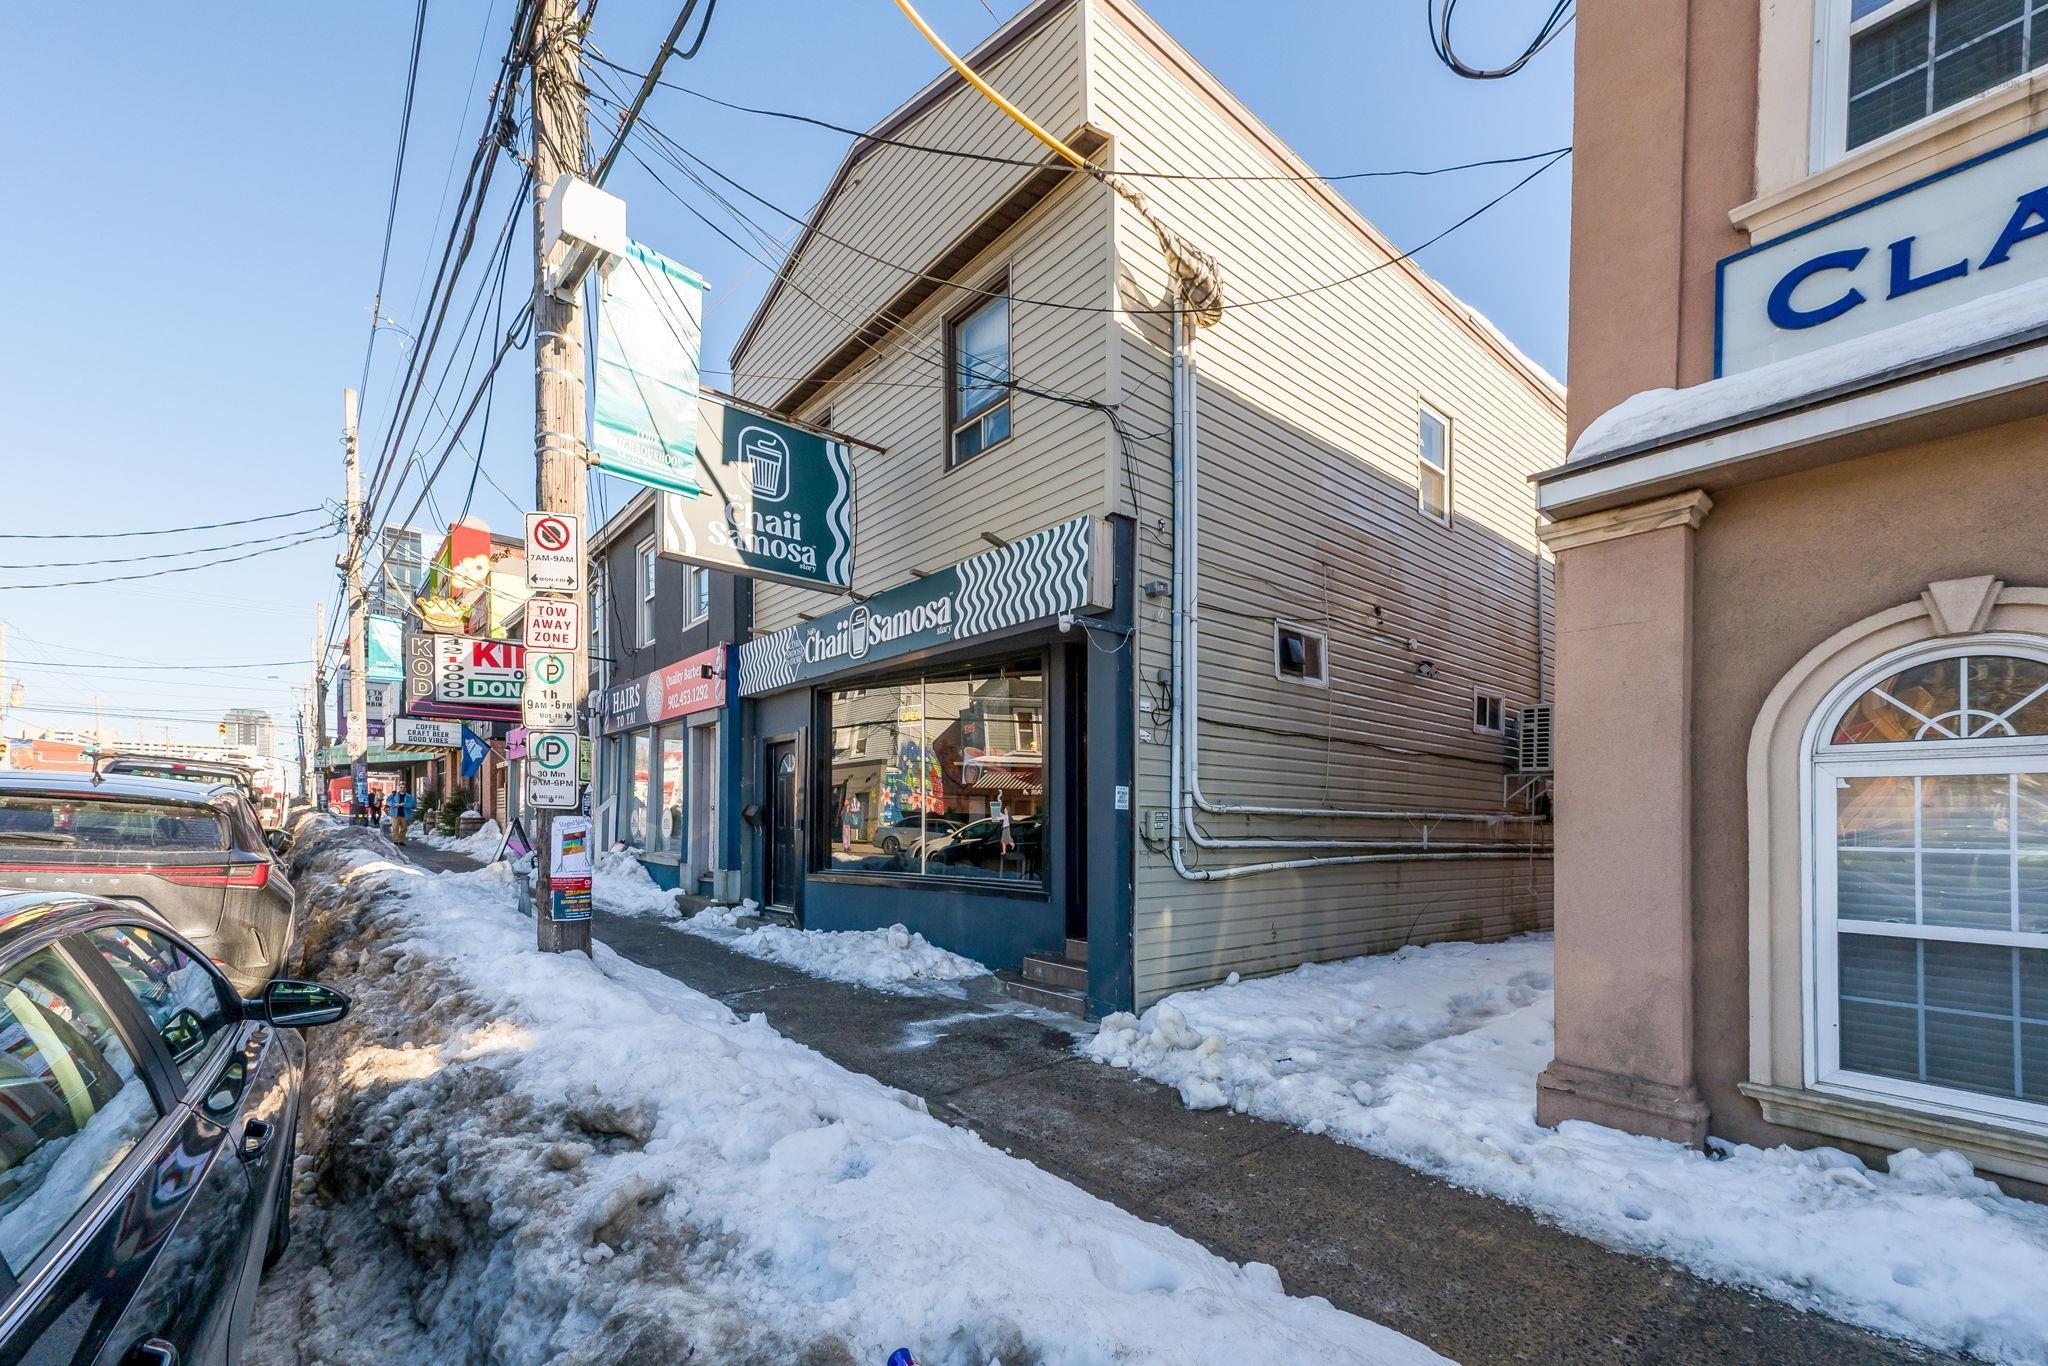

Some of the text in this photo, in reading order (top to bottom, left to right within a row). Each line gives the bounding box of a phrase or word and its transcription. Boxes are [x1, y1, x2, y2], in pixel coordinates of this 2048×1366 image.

[610, 436, 684, 468] IGHBOURHOOD
[725, 502, 802, 541] Chaii
[708, 520, 817, 566] Samosa
[530, 554, 574, 563] 7AM-9AM
[537, 606, 567, 617] TOW
[533, 619, 571, 630] AWAY
[805, 620, 848, 663] Chaii
[868, 596, 953, 645] Samosa
[936, 624, 953, 635] story
[534, 632, 569, 643] ZONE
[666, 671, 684, 690] Quality
[612, 683, 641, 714] HAIRS
[667, 683, 709, 710] 902.453.1292
[616, 714, 625, 728] TO
[537, 770, 566, 778] 30 Min
